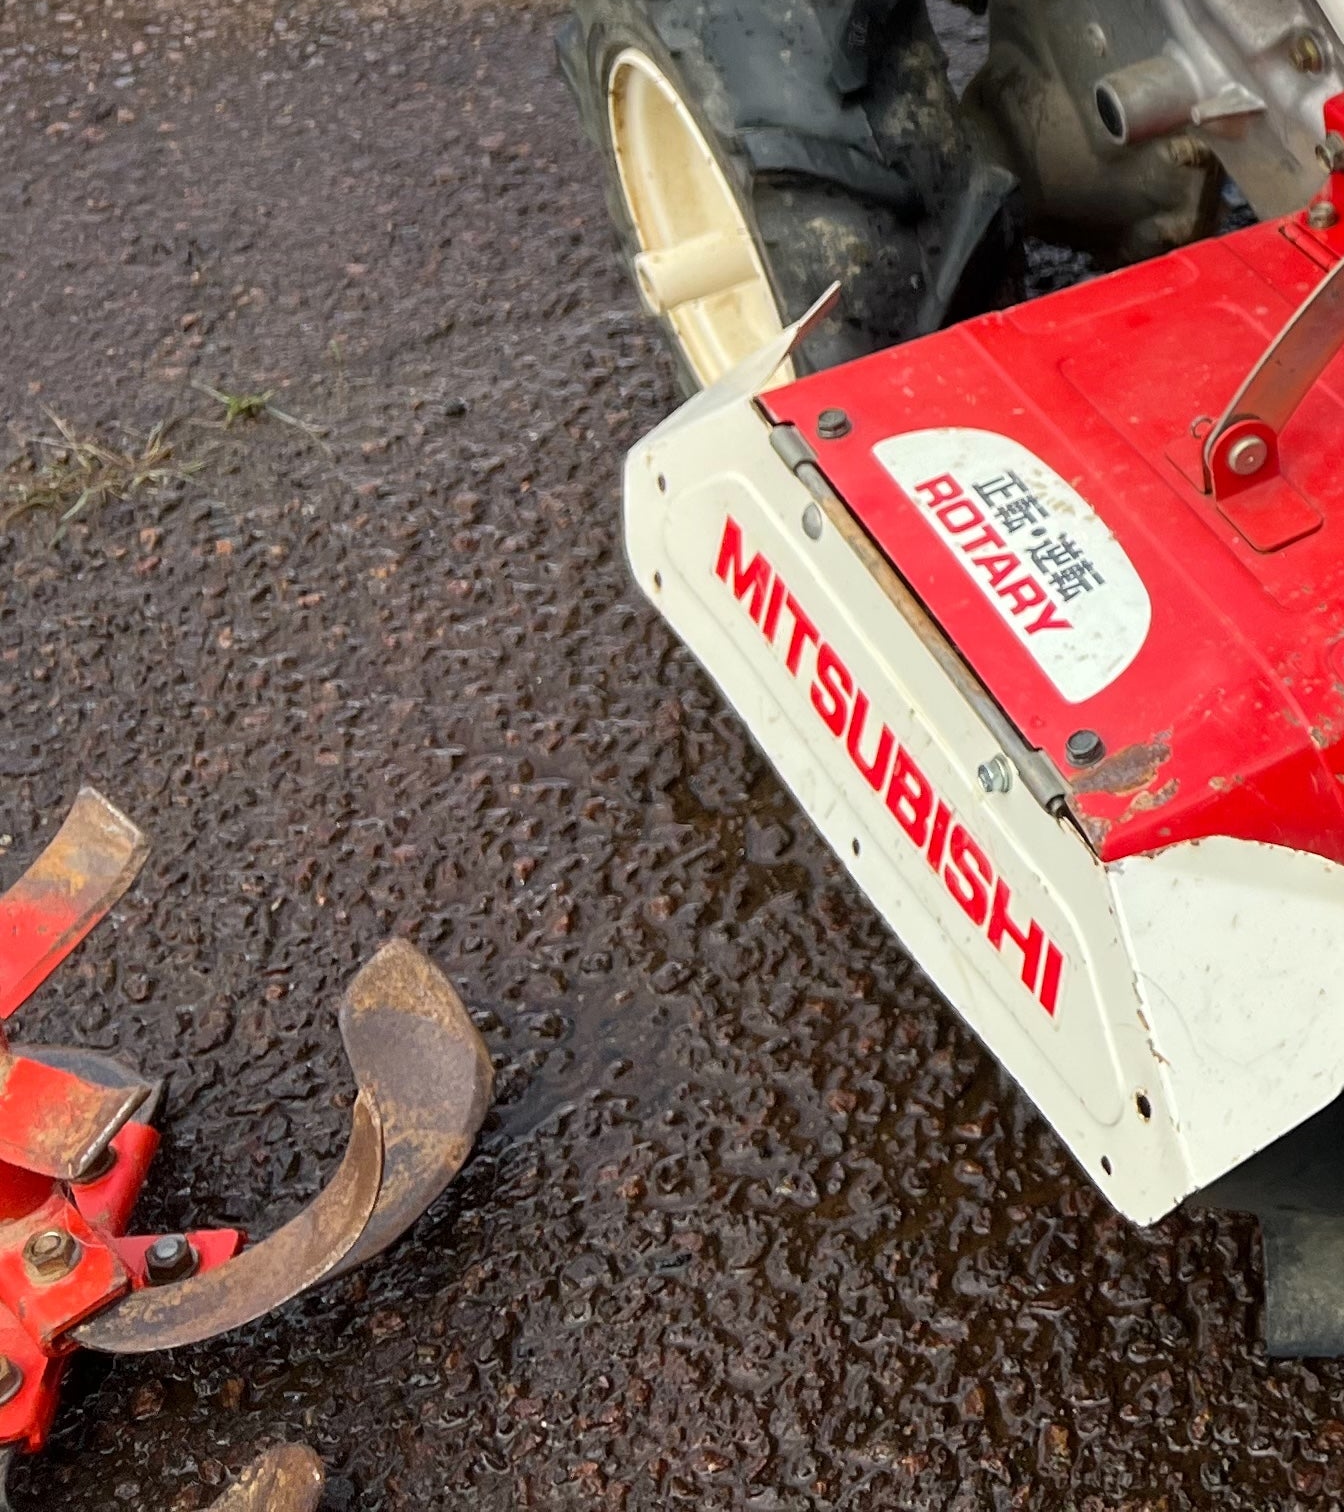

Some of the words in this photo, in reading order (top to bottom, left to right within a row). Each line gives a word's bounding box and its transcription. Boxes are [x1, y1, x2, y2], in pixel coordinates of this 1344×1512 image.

[913, 472, 1074, 638] ROTARY
[971, 468, 1105, 602] 正転・逆転
[710, 514, 1066, 1019] MITSUBISHI
